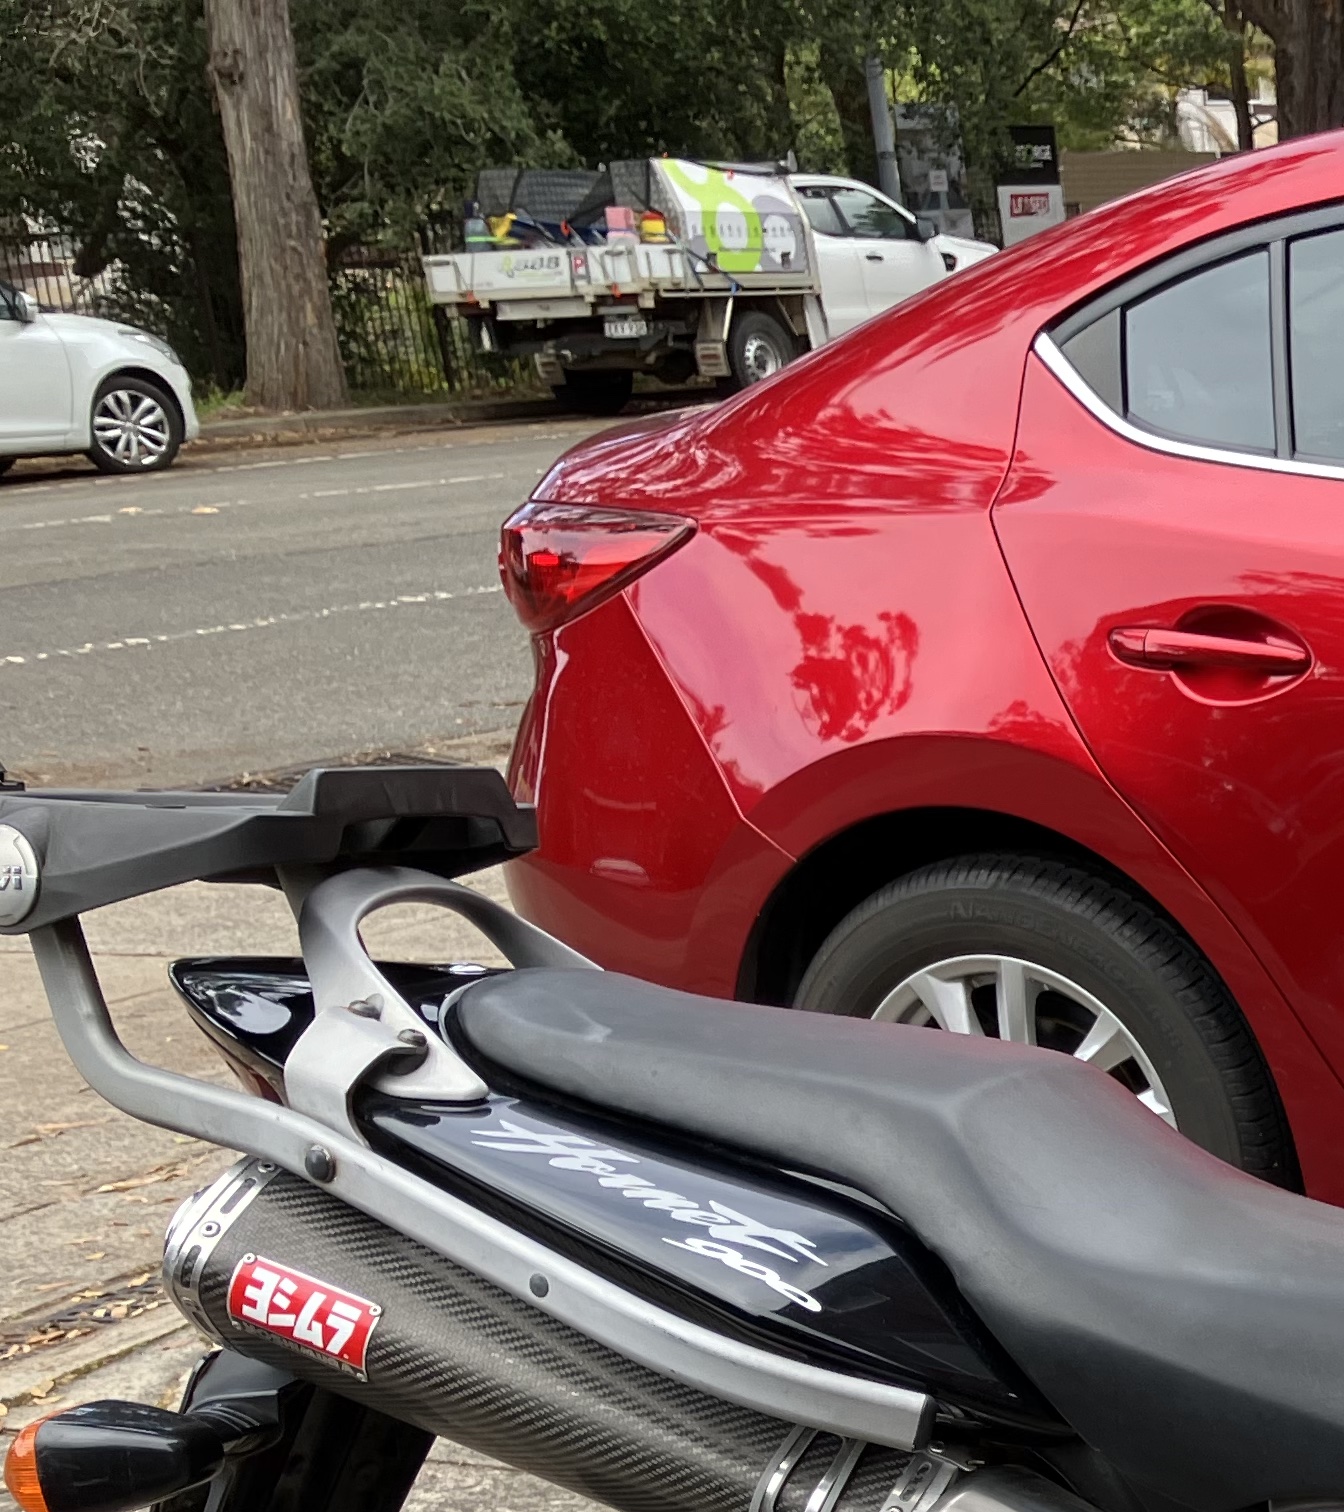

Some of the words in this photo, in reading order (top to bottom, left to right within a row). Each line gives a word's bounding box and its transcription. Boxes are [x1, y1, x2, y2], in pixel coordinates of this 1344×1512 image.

[470, 1119, 829, 1267] Hornet
[242, 1266, 362, 1355] ヨシムラ
[661, 1237, 823, 1313] 900
